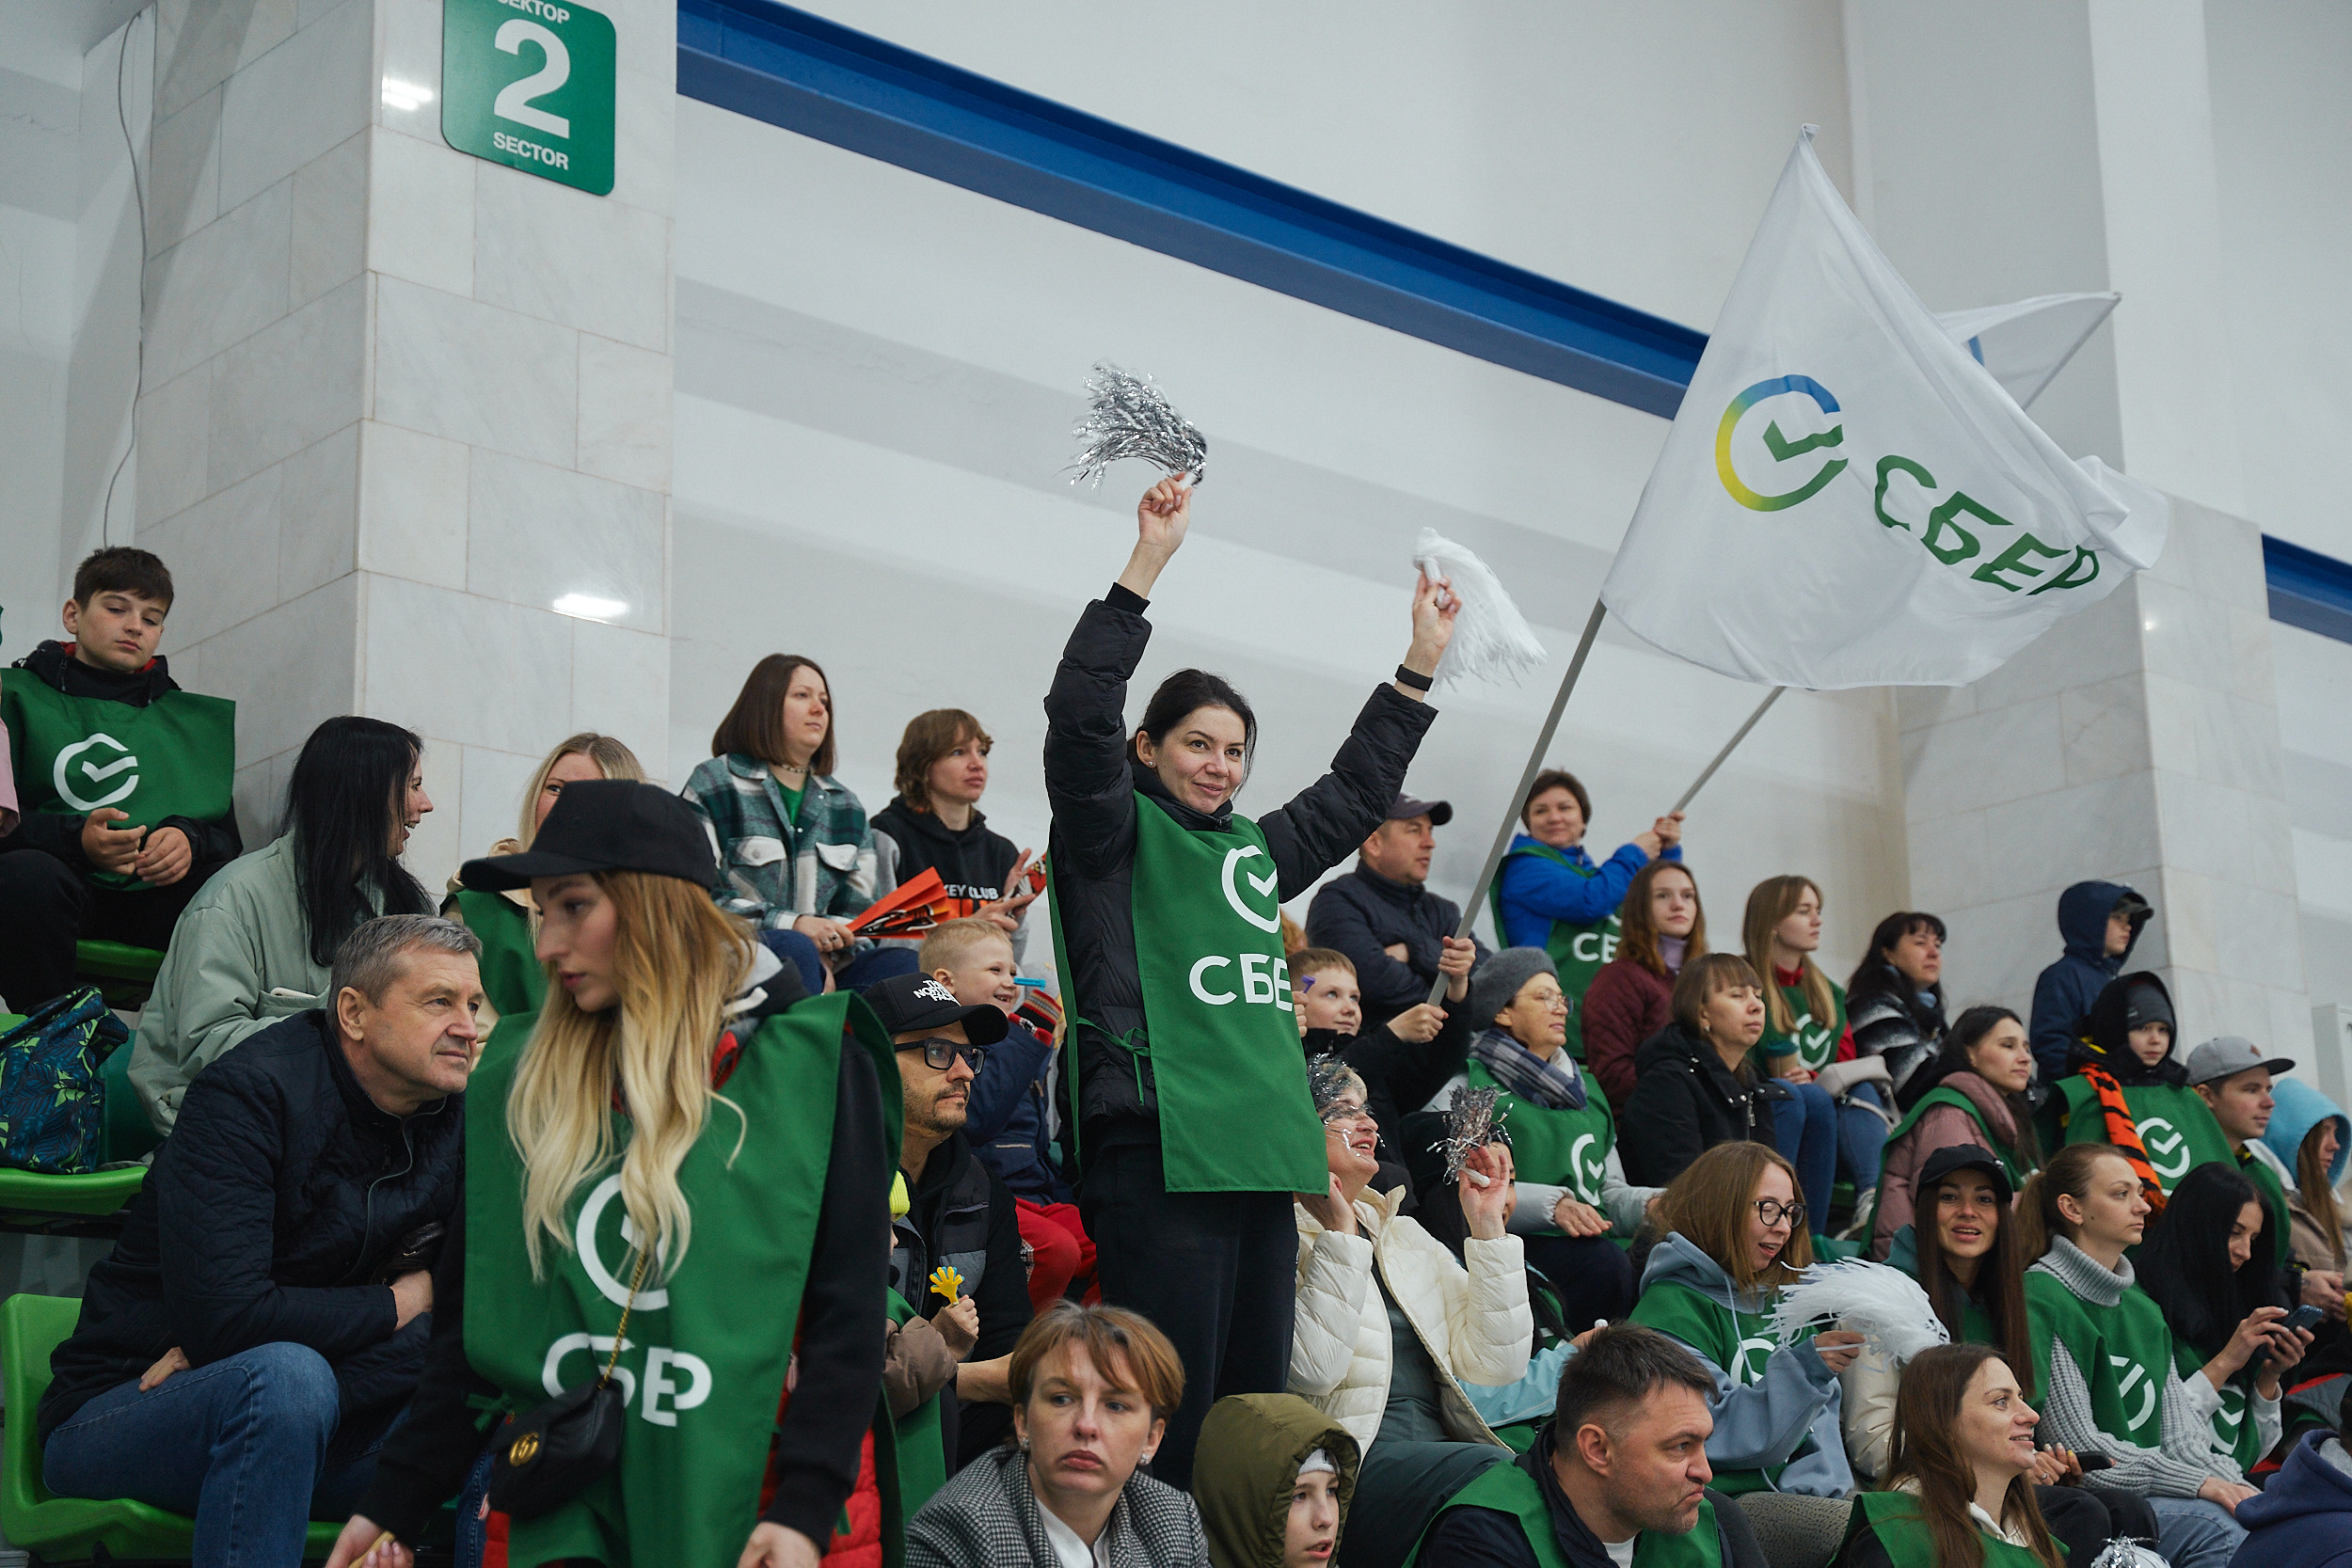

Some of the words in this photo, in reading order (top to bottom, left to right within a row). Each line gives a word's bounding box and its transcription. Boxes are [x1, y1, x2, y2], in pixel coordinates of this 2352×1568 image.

[498, 0, 570, 24] ЕКТОР
[494, 18, 571, 139] 2
[493, 132, 569, 170] SECTOR
[1874, 455, 2100, 596] СБЕР
